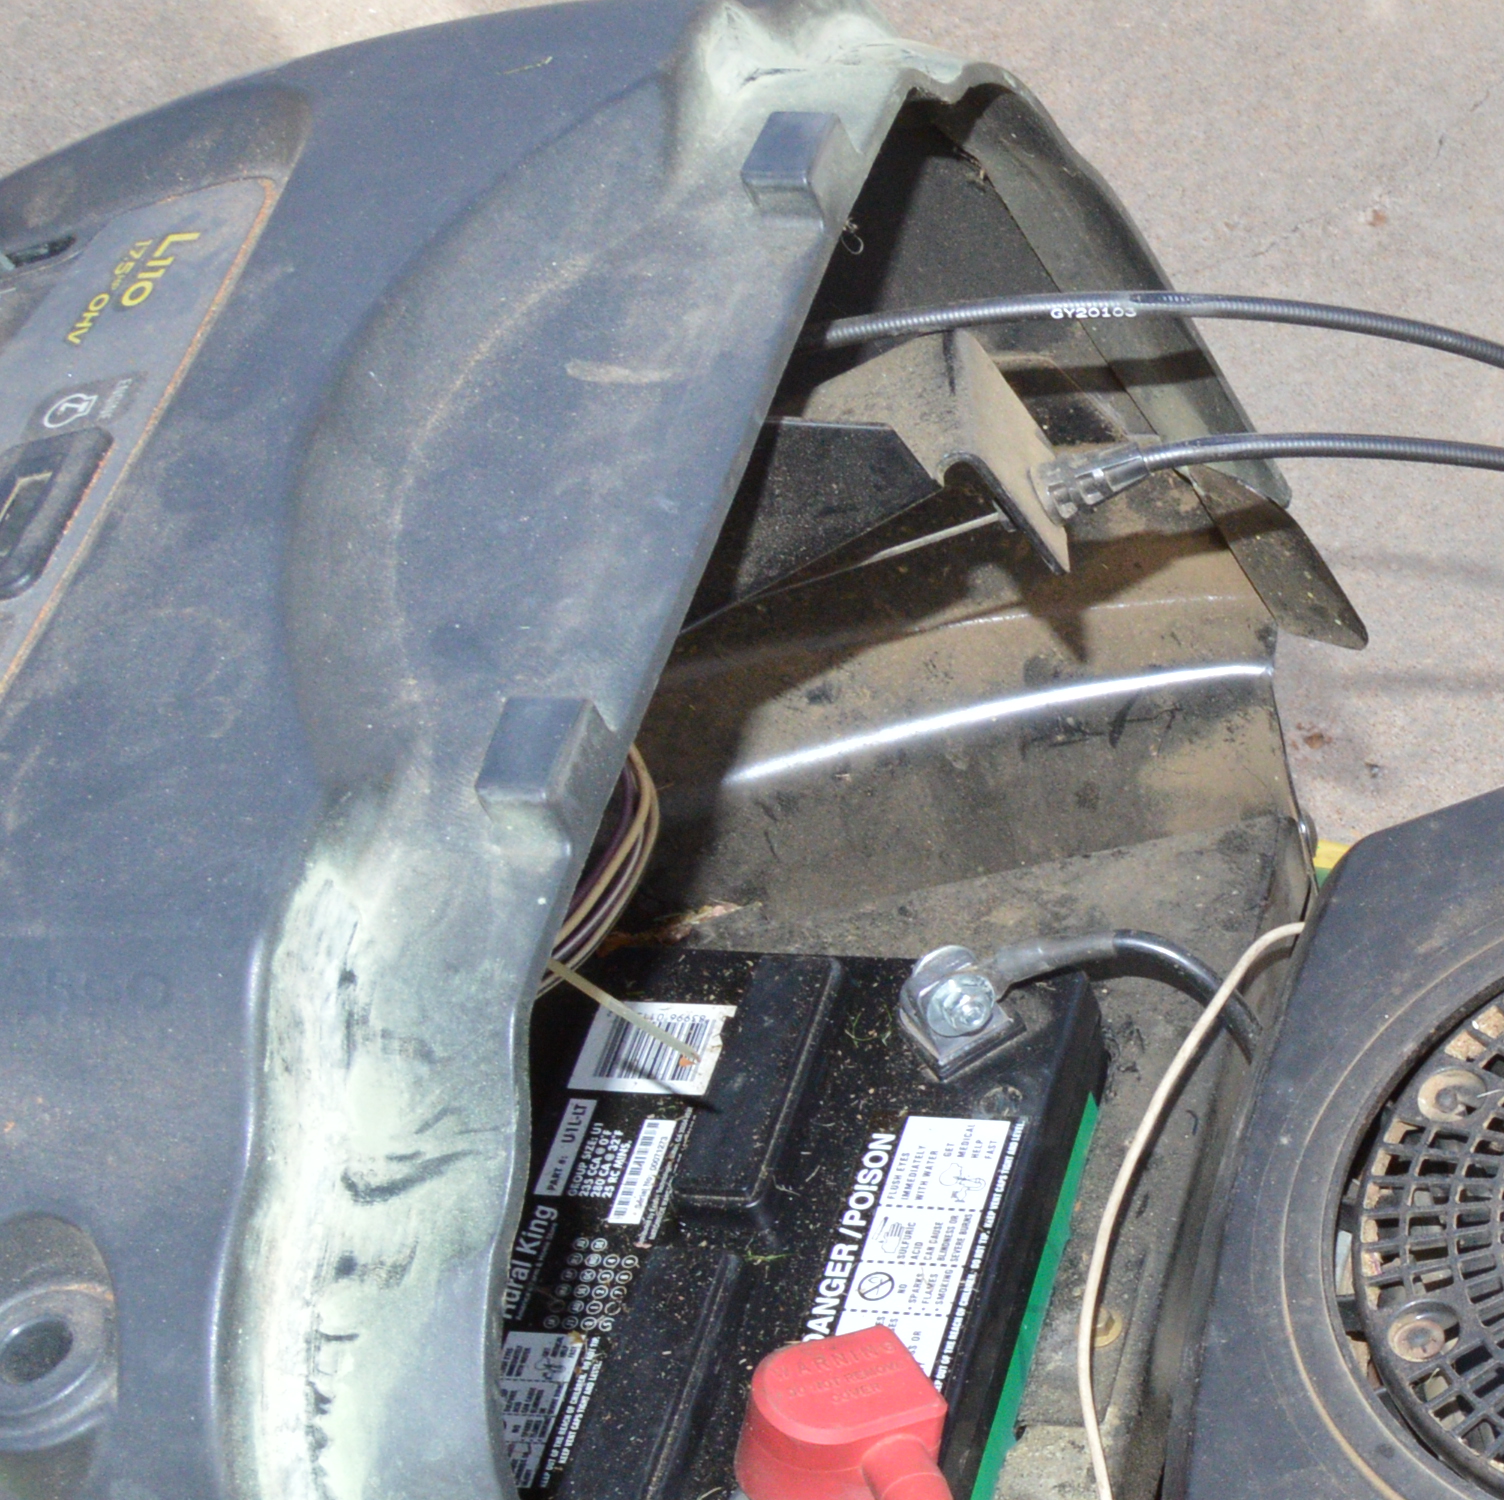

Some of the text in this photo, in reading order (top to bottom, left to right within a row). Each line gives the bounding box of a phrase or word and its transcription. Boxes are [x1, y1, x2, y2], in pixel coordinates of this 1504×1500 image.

[121, 232, 200, 306] L110
[67, 293, 110, 345] OHV
[943, 1142, 955, 1158] GET
[956, 1124, 976, 1158] MEDICAL
[971, 1139, 983, 1159] HELP
[984, 1140, 998, 1159] FAST
[546, 1167, 563, 1191] PART
[567, 1161, 587, 1197] GROUP
[581, 1137, 599, 1160] SIZE:
[579, 1178, 594, 1197] 235
[587, 1156, 603, 1176] CCA
[598, 1163, 612, 1177] CA
[607, 1170, 621, 1184] RC
[886, 1152, 911, 1200] FLUSH EYES
[900, 1145, 926, 1200] IMMEDIATELY
[914, 1150, 939, 1201] WITH WATER
[601, 1185, 615, 1198] 25
[515, 1204, 559, 1255] King
[897, 1221, 917, 1259] SULFURIC
[923, 1221, 944, 1261] CAN CAUSE
[936, 1215, 959, 1262] BLINDNESS OR
[950, 1213, 973, 1262] SEVERE BURNS
[910, 1241, 924, 1260] ACID
[897, 1283, 908, 1295] NO
[908, 1273, 924, 1304] SPARKS
[921, 1273, 939, 1304] FLAMES
[935, 1269, 954, 1305] SMOKING
